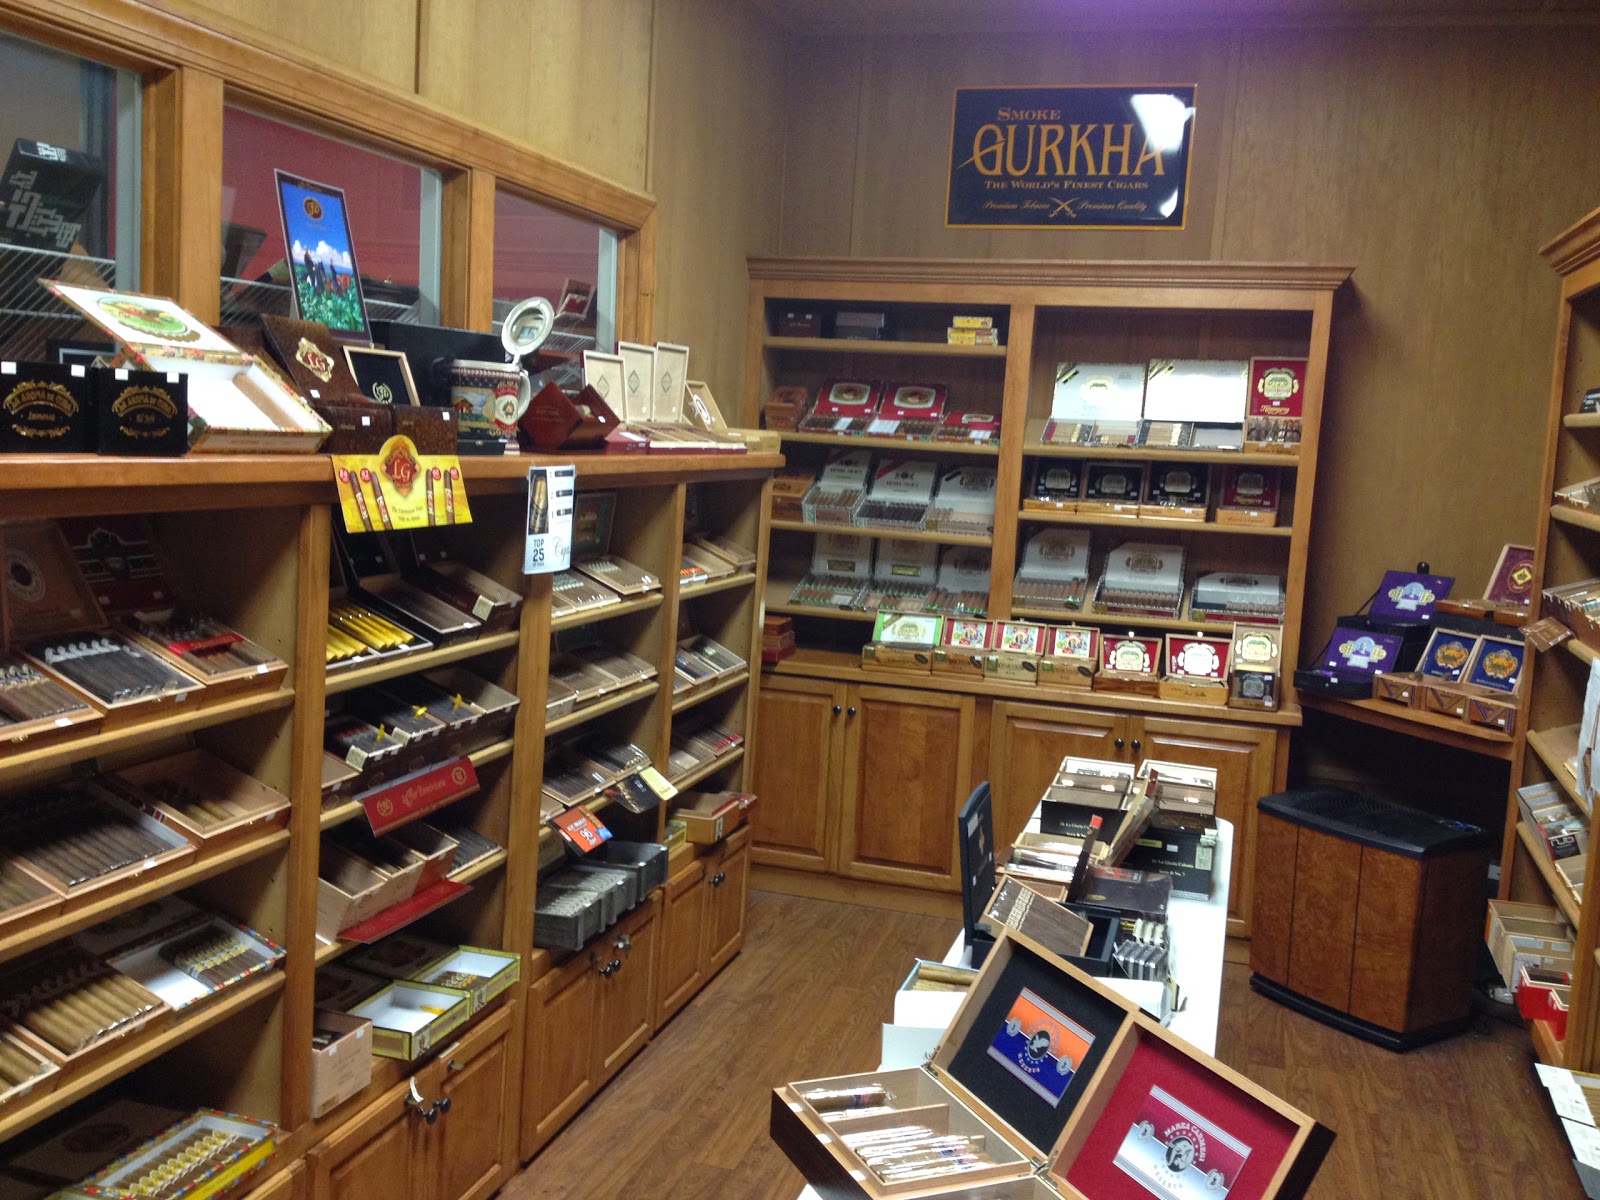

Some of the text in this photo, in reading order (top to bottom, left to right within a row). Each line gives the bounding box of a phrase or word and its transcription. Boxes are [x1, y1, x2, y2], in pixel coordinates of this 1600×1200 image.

[997, 107, 1061, 121] SMOKE
[960, 123, 1166, 177] GURKHA
[985, 180, 1149, 189] THE WORLD'S FINEST CIGARS
[982, 200, 1018, 211] Premium
[1077, 200, 1115, 211] Premium
[1117, 200, 1148, 212] Quality
[533, 539, 545, 548] TOP
[532, 548, 545, 562] 25
